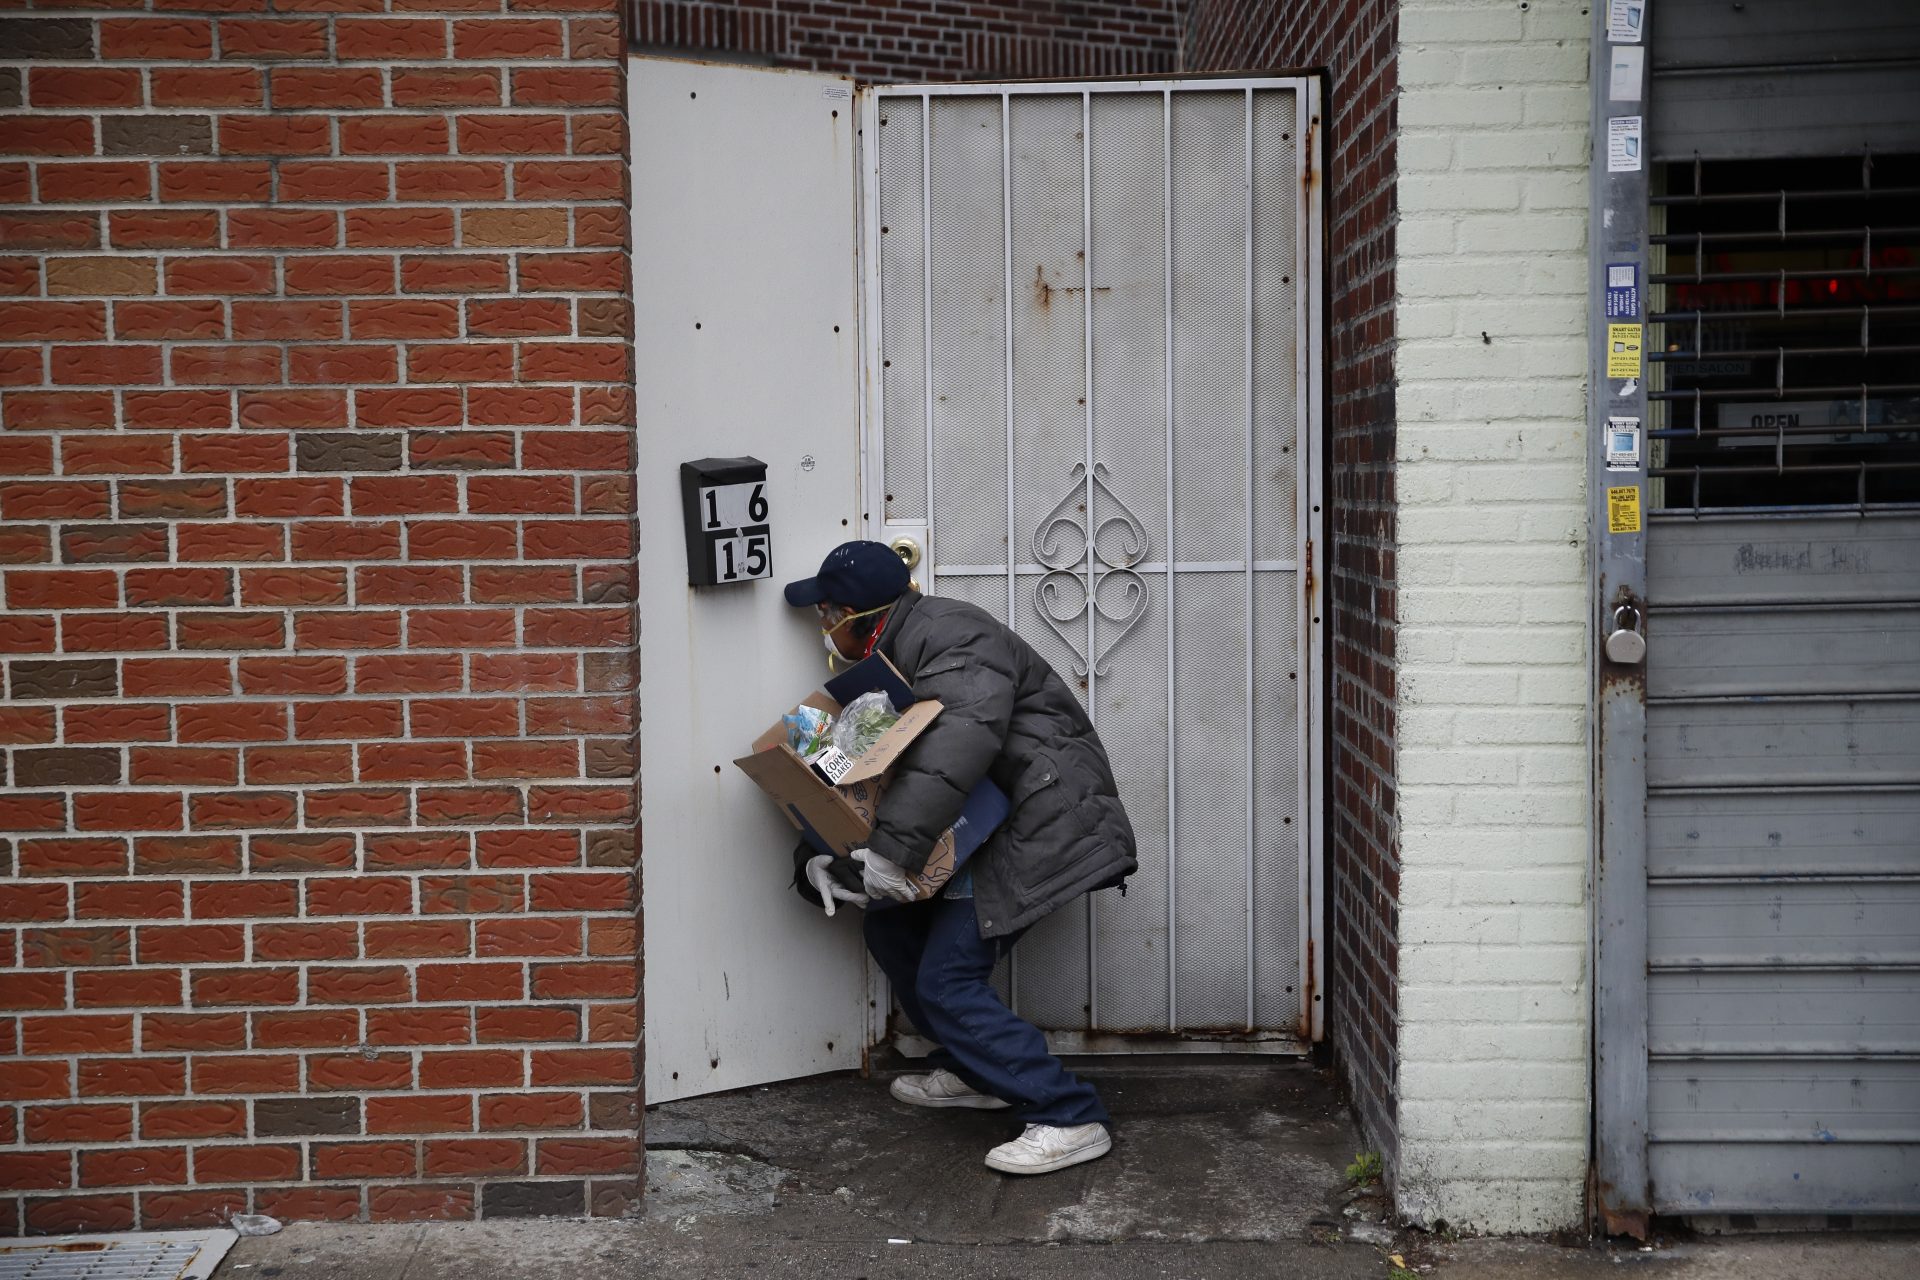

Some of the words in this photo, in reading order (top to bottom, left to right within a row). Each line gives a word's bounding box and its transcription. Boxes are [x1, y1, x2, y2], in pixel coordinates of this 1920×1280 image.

[1698, 363, 1745, 374] SALON
[1751, 414, 1800, 428] OPEN
[825, 752, 846, 774] CORN
[831, 760, 852, 781] FLAKES
